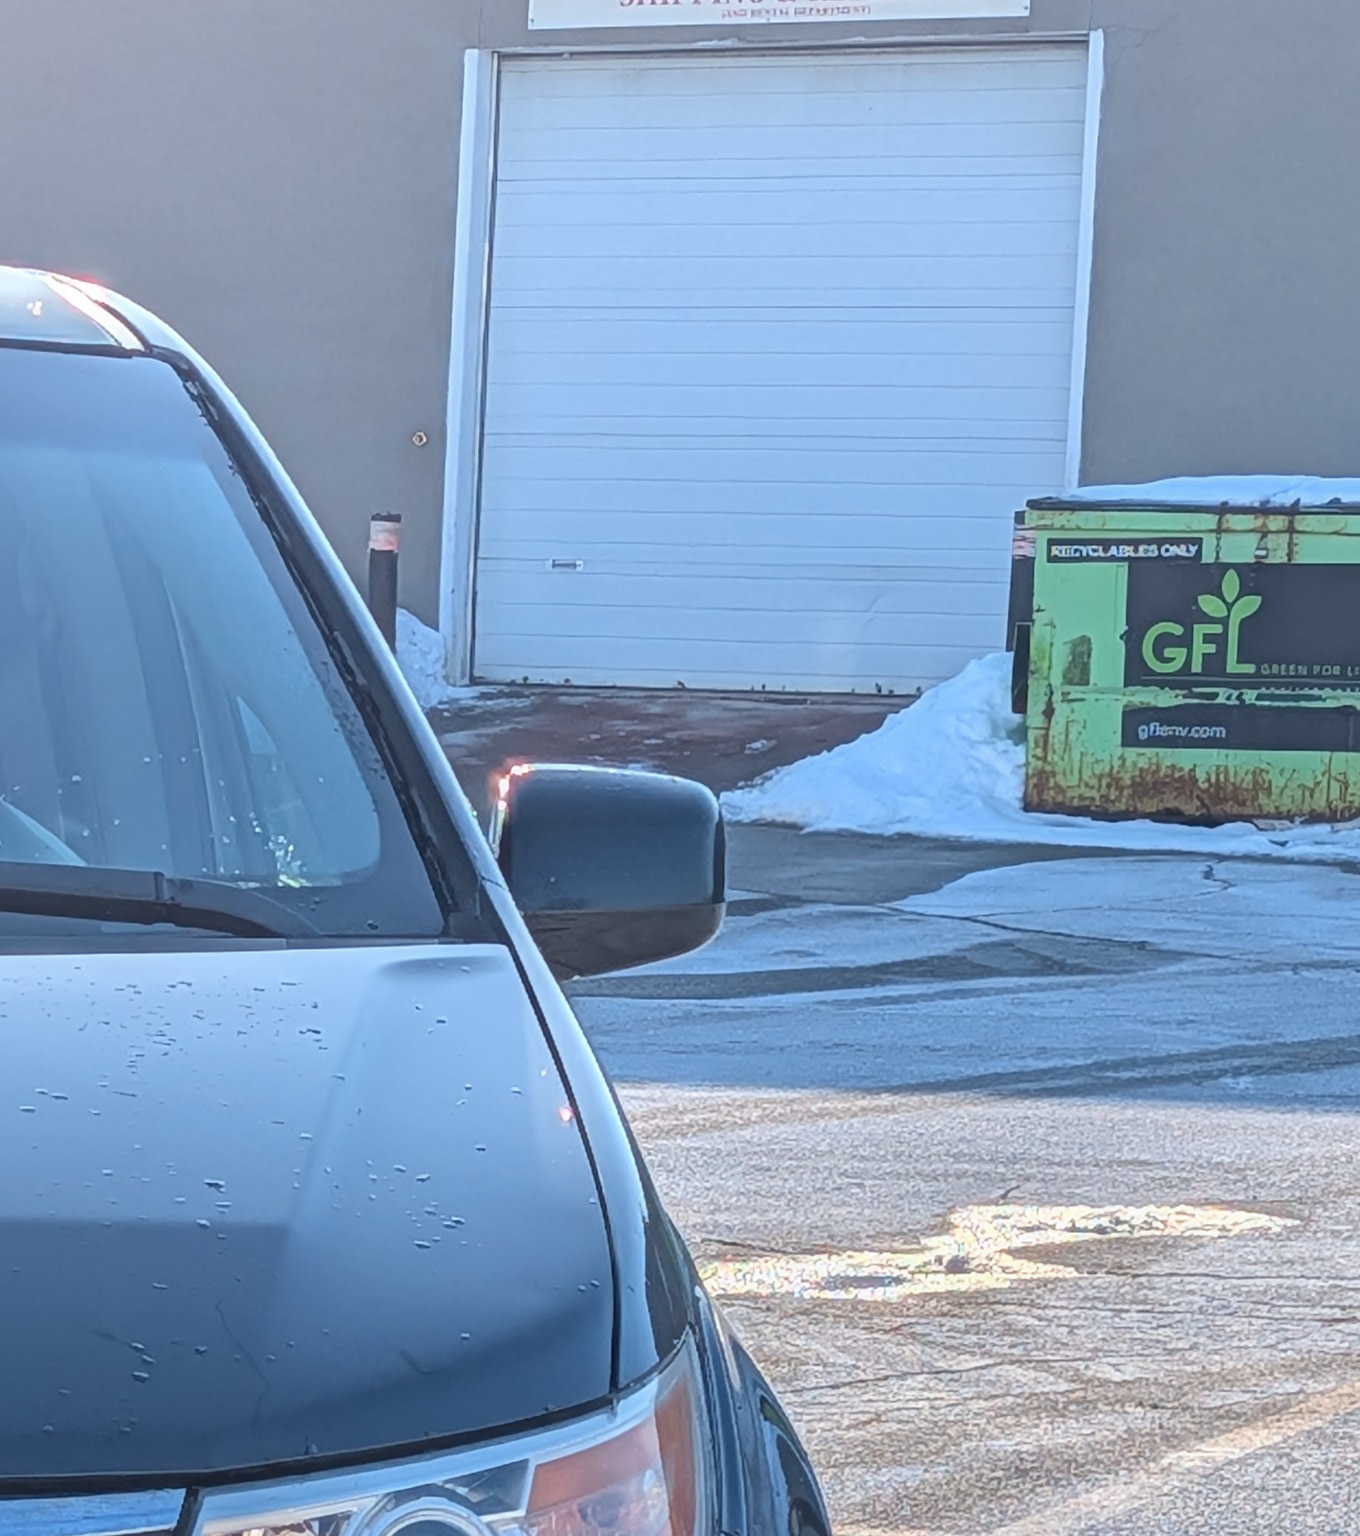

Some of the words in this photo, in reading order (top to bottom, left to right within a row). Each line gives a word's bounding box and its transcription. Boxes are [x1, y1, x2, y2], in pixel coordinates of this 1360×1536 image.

[1050, 544, 1158, 557] RECYCLABLES
[1160, 543, 1198, 557] ONLY
[1142, 596, 1262, 674] GFL
[1260, 663, 1308, 676] GREEN
